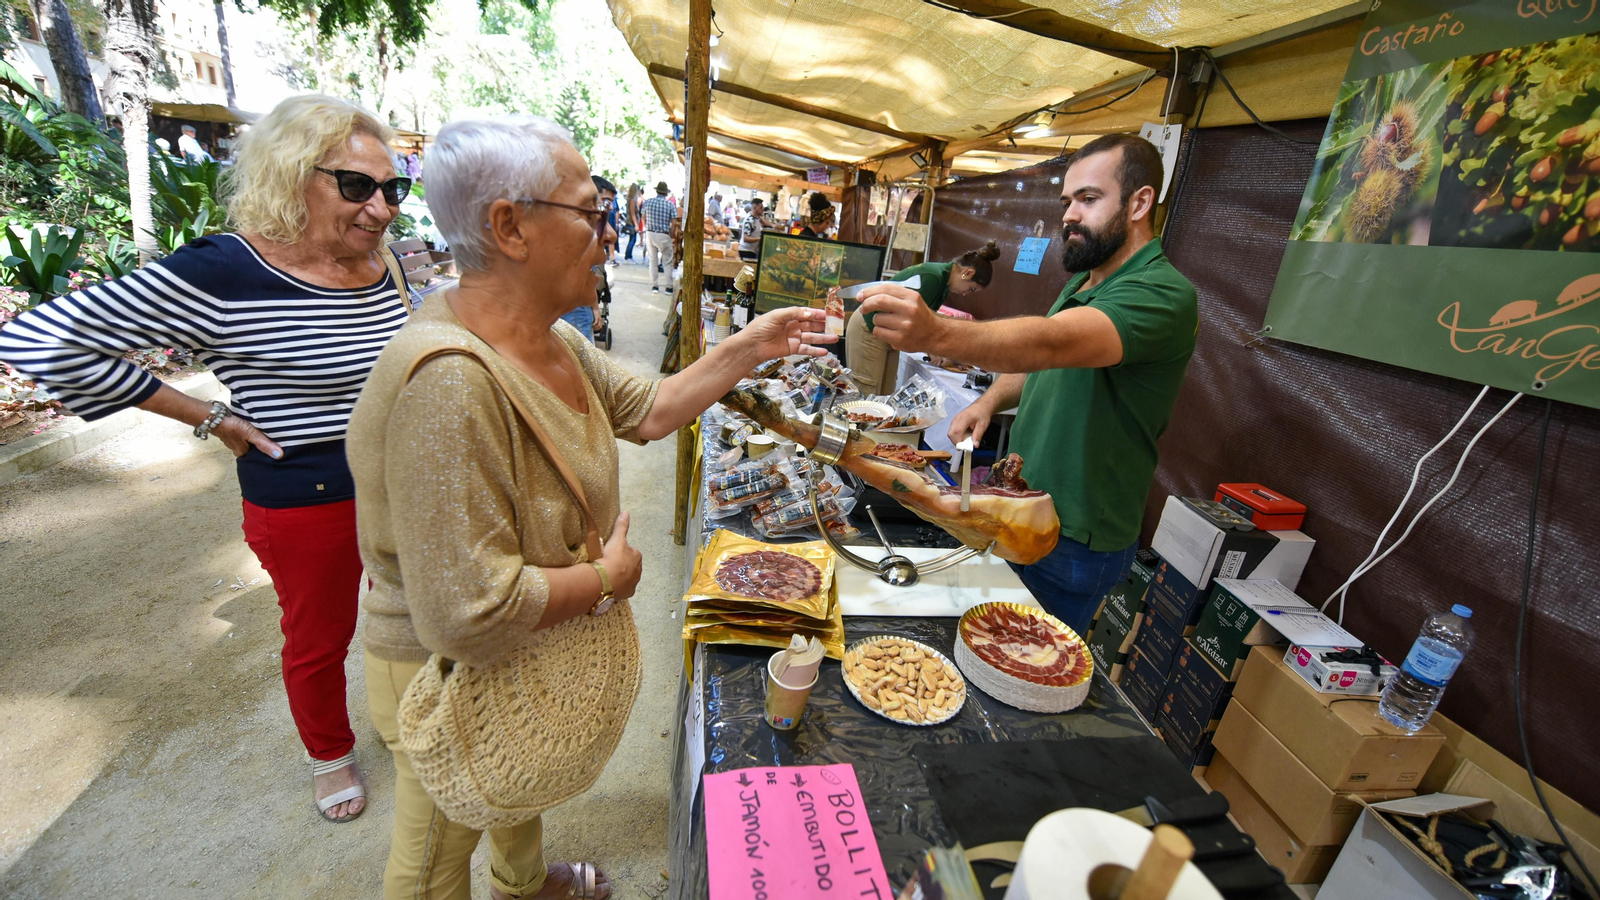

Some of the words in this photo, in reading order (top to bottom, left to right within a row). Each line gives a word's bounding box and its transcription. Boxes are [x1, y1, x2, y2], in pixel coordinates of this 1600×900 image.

[1360, 12, 1465, 56] Castaño
[1199, 638, 1228, 668] Alcázar
[1299, 652, 1309, 662] PRO
[765, 771, 777, 785] DE
[739, 789, 770, 860] JAMÓN
[796, 790, 833, 891] EMBUTIDO
[828, 789, 882, 900] BOLLIT
